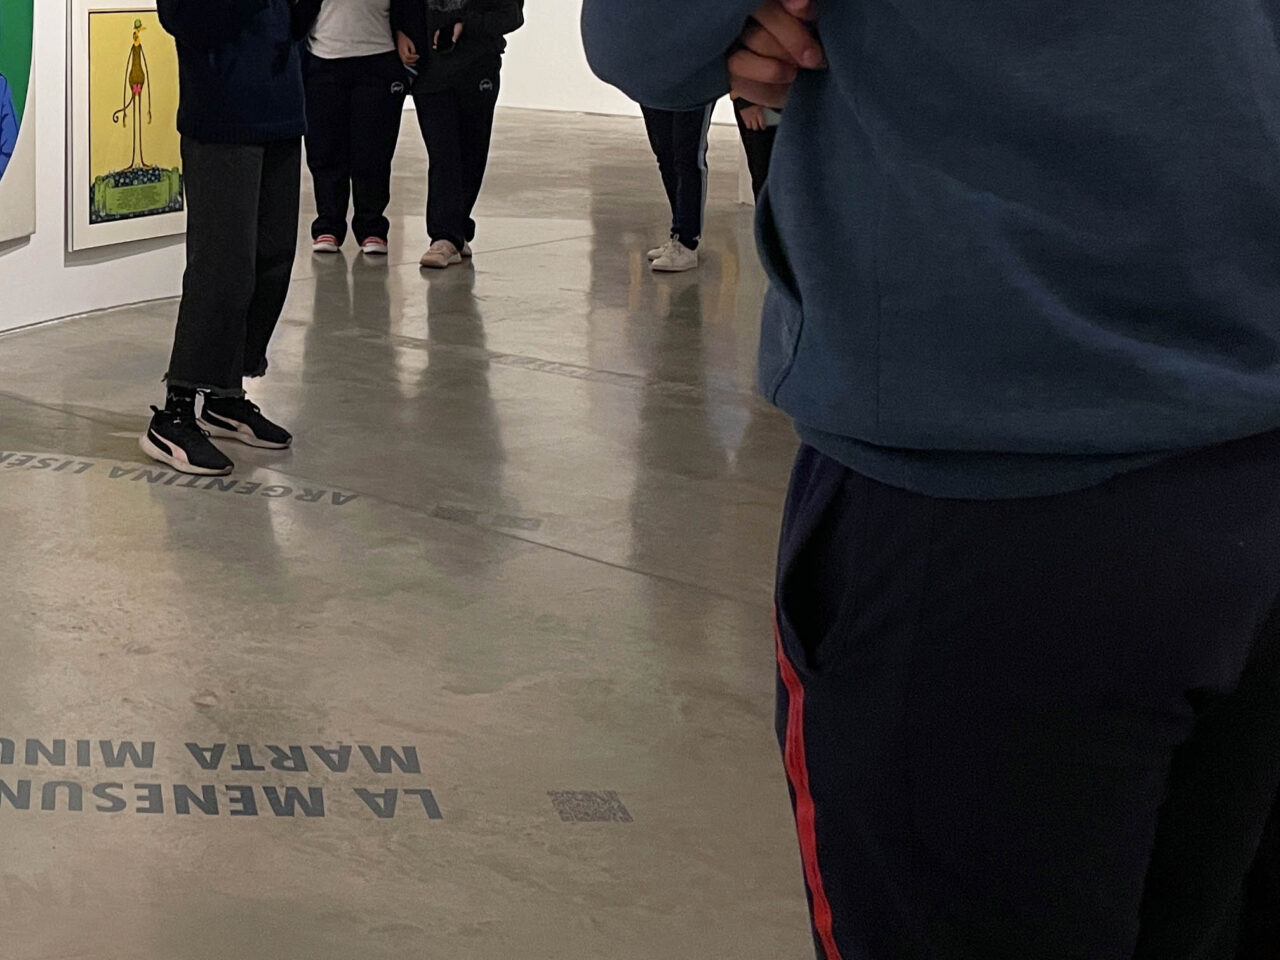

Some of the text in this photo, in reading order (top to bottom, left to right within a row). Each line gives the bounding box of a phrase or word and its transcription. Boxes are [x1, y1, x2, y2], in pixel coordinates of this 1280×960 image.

[108, 466, 359, 506] ARGENTINA
[185, 741, 421, 774] MARTA
[352, 787, 444, 820] LA
